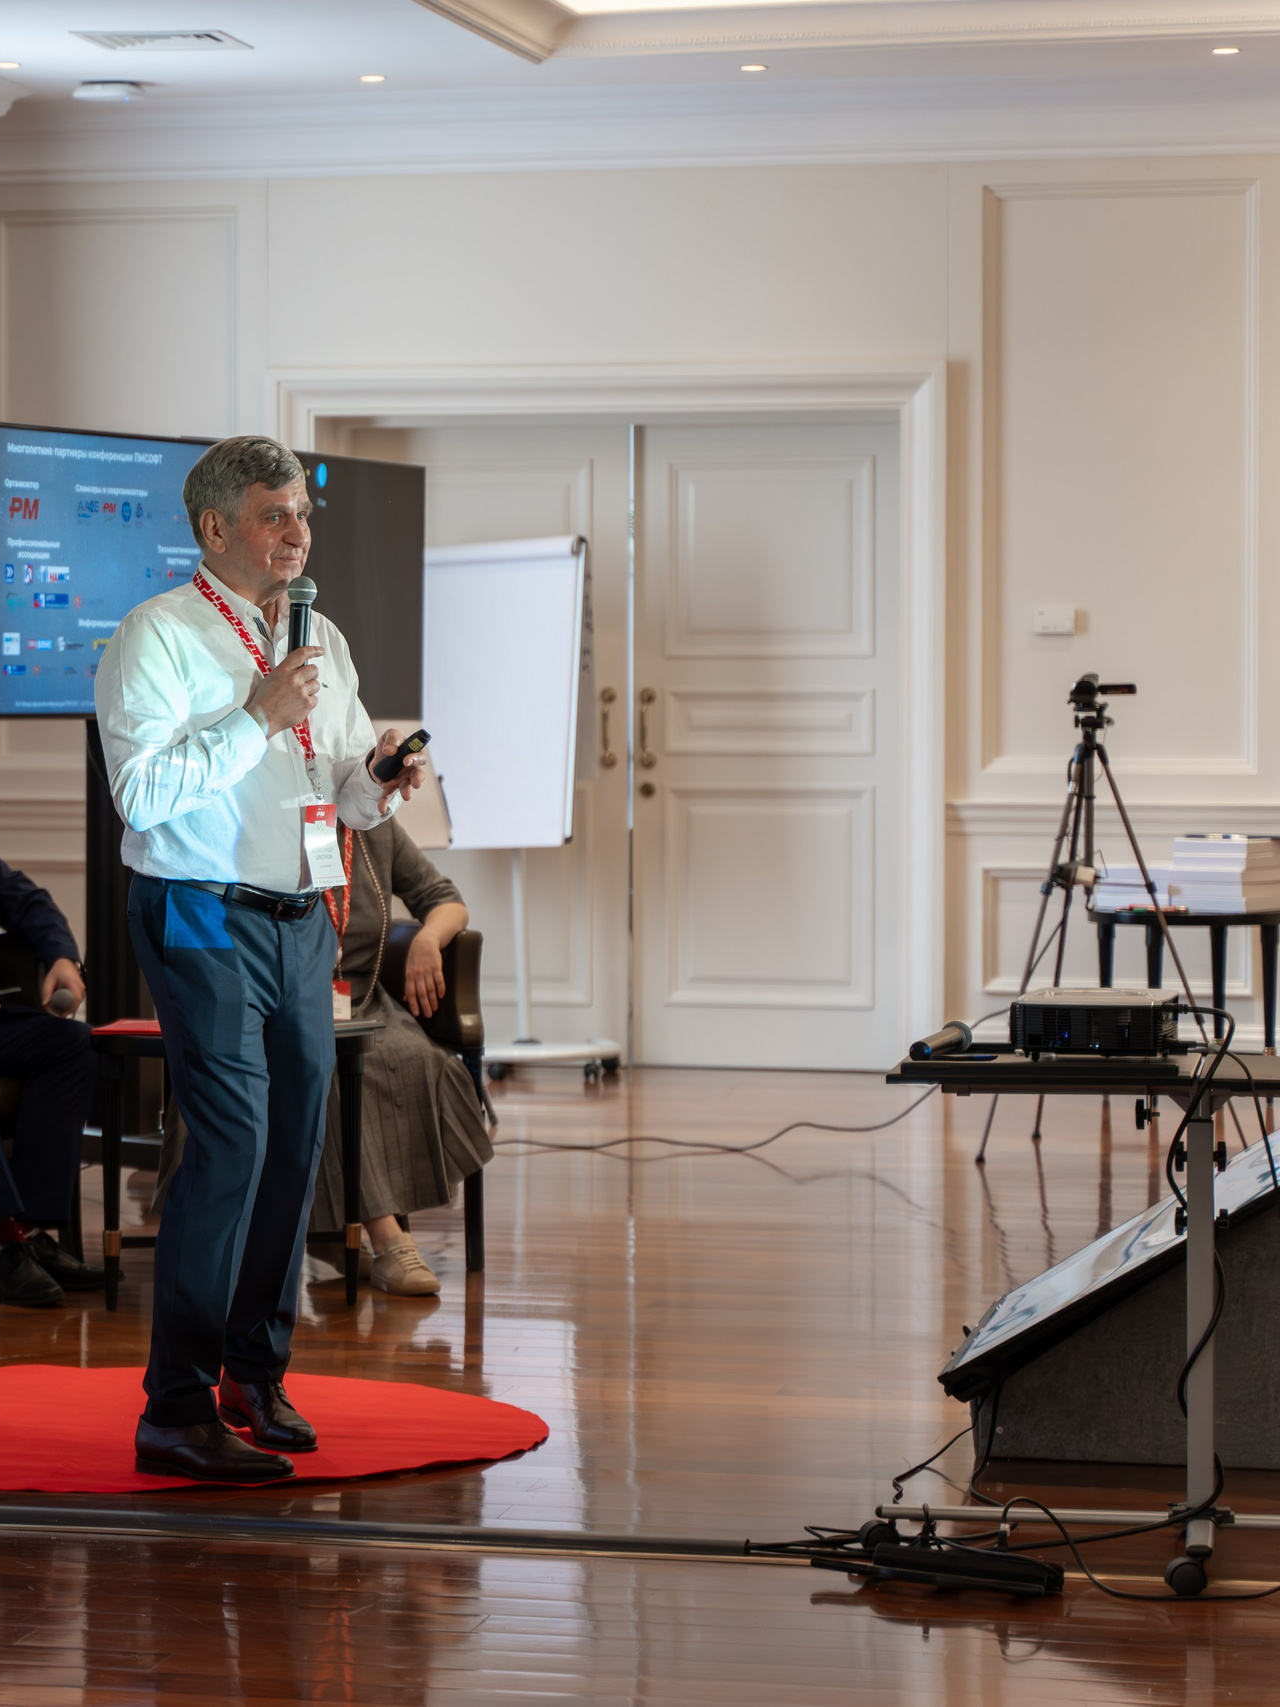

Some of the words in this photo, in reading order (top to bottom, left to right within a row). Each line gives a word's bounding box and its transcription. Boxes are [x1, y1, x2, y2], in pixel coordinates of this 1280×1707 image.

[7, 442, 53, 456] Многолетние
[54, 446, 87, 460] партнеры
[88, 448, 133, 463] конференции
[134, 452, 163, 464] ПМСОФТ
[4, 478, 40, 490] Организатор
